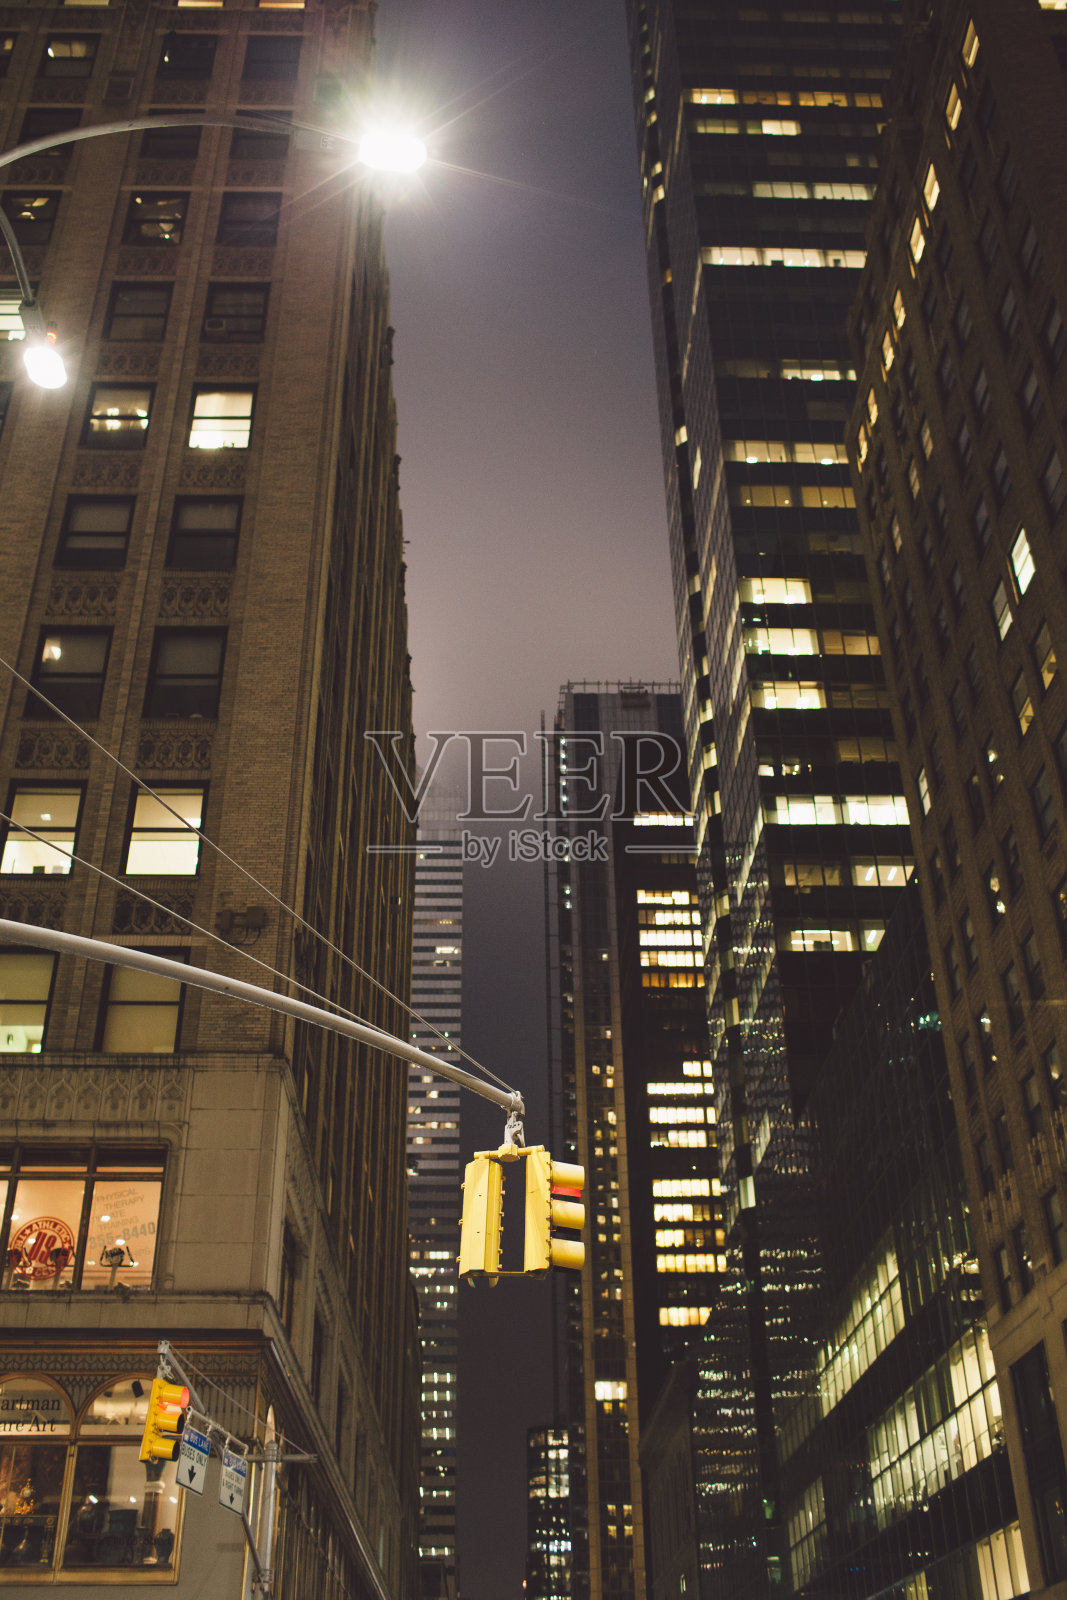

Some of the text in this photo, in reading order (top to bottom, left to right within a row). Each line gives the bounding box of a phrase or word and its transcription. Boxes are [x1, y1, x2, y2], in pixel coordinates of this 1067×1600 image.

[96, 1187, 138, 1202] PHYSICAL
[104, 1195, 145, 1211] THERAPY
[32, 1221, 70, 1243] ATHLETIC
[98, 1216, 139, 1231] TRAINING
[89, 1222, 156, 1249] 355-8440
[1, 1394, 61, 1411] artman
[29, 1415, 56, 1432] Art
[190, 1432, 209, 1451] BUS LANE
[182, 1444, 209, 1467] BUSES ONLY
